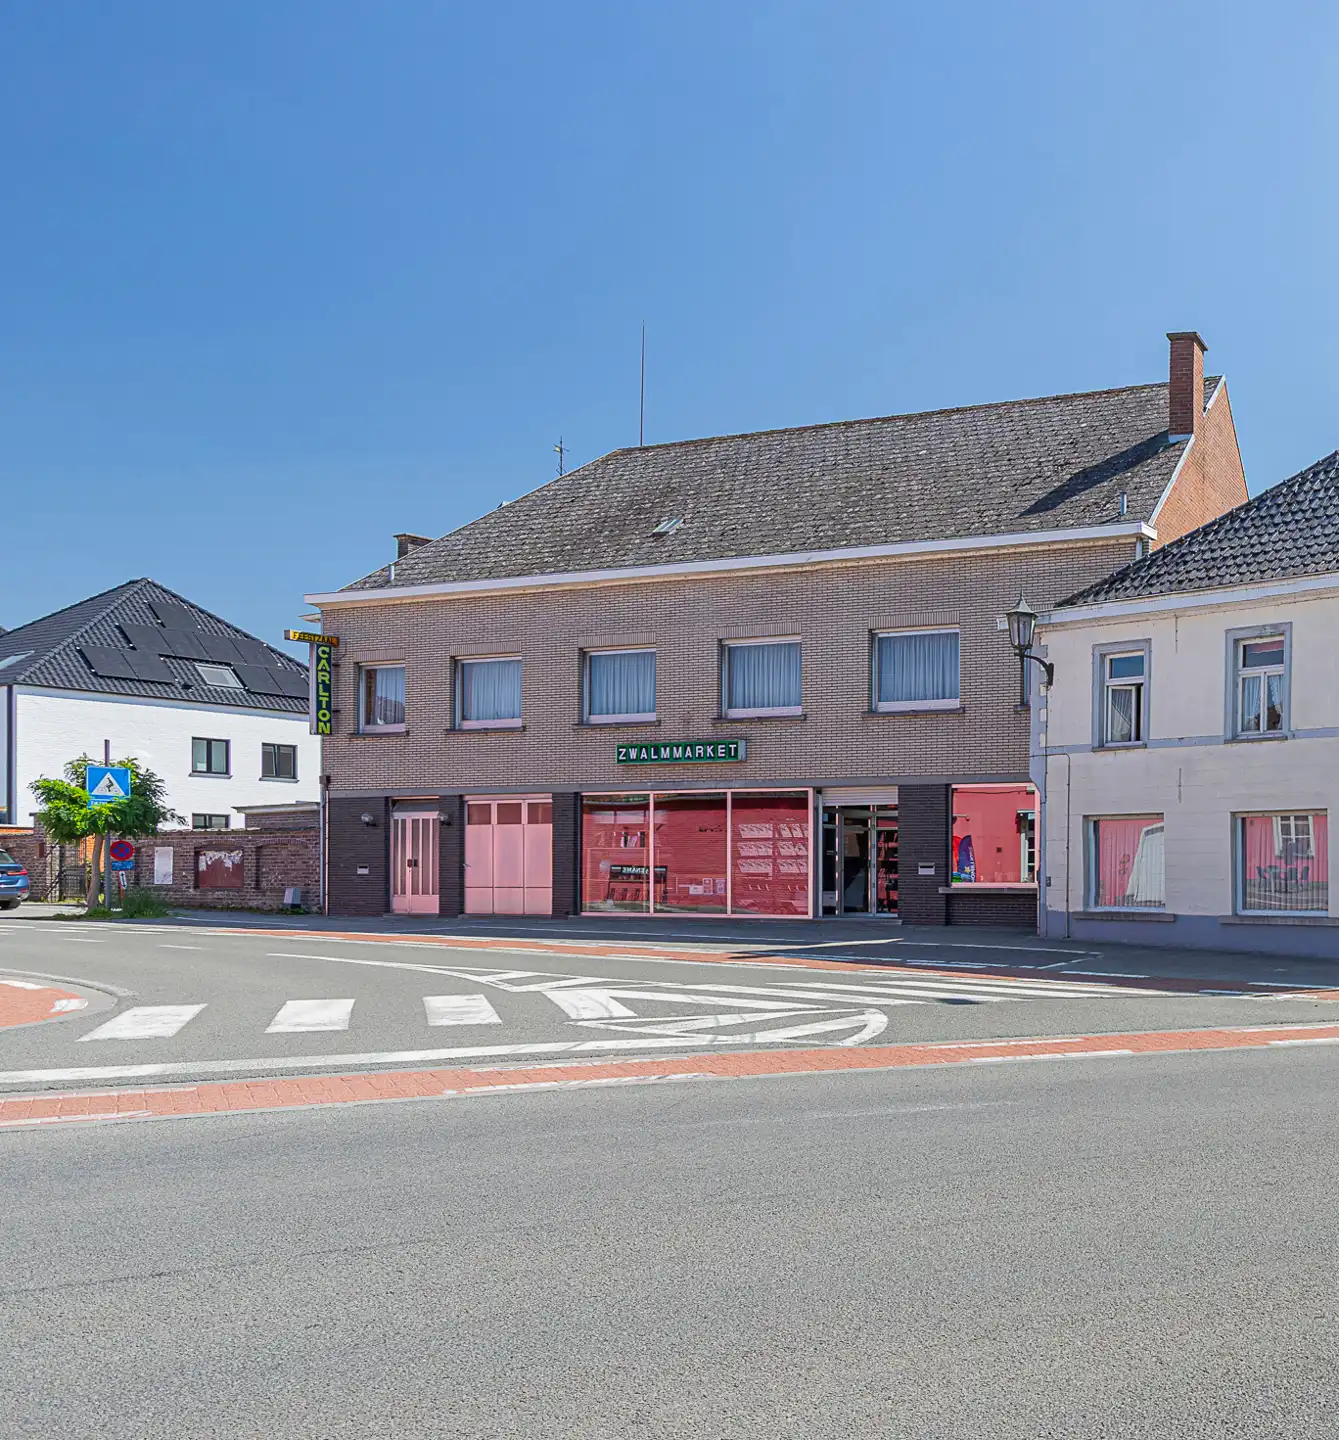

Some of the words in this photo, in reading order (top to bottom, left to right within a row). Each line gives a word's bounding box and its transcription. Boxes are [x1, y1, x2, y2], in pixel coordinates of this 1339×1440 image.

[293, 632, 335, 645] FEESTZAAL
[317, 646, 331, 734] CARLTON
[618, 744, 738, 760] ZWALMMARKET
